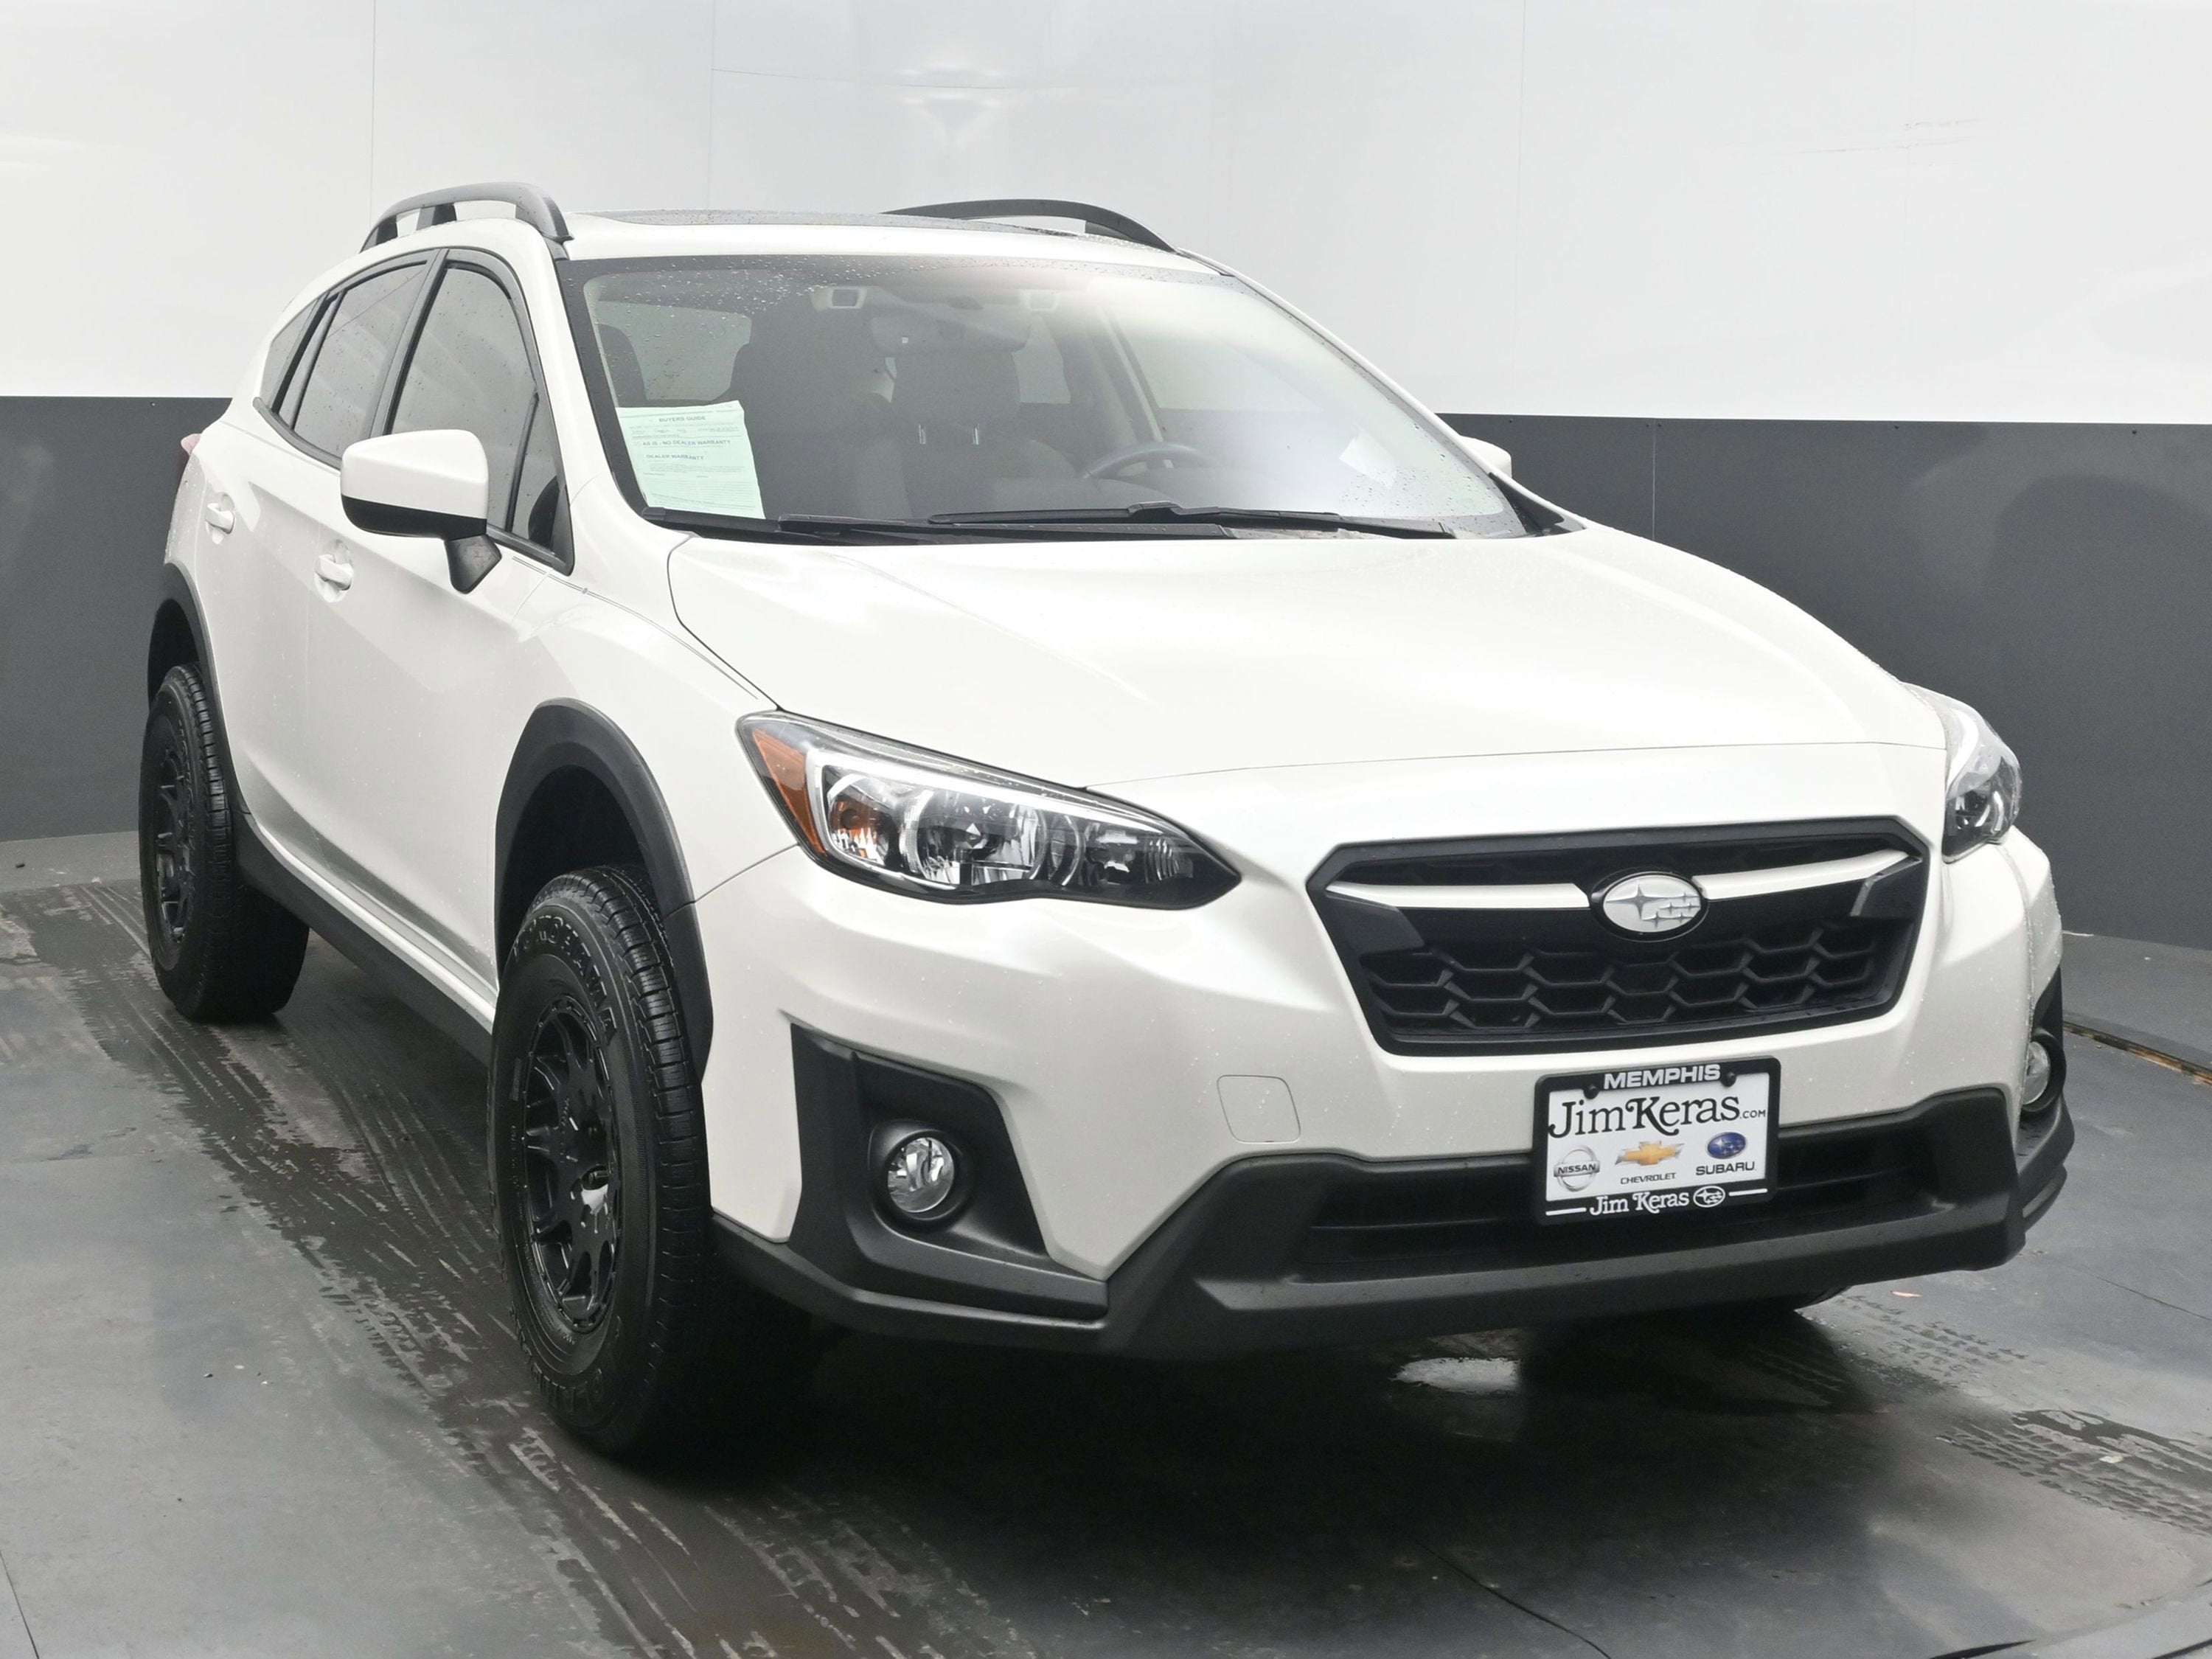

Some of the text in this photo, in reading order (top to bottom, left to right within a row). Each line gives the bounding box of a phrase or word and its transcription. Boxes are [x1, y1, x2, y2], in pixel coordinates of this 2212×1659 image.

[1604, 1064, 1721, 1090] MEMPHIS
[1557, 1163, 1596, 1175] NISSAN
[1696, 1161, 1756, 1176] SUBARU
[1620, 1172, 1677, 1185] CHEVROLET
[1590, 1191, 1690, 1216] Jim Keras
